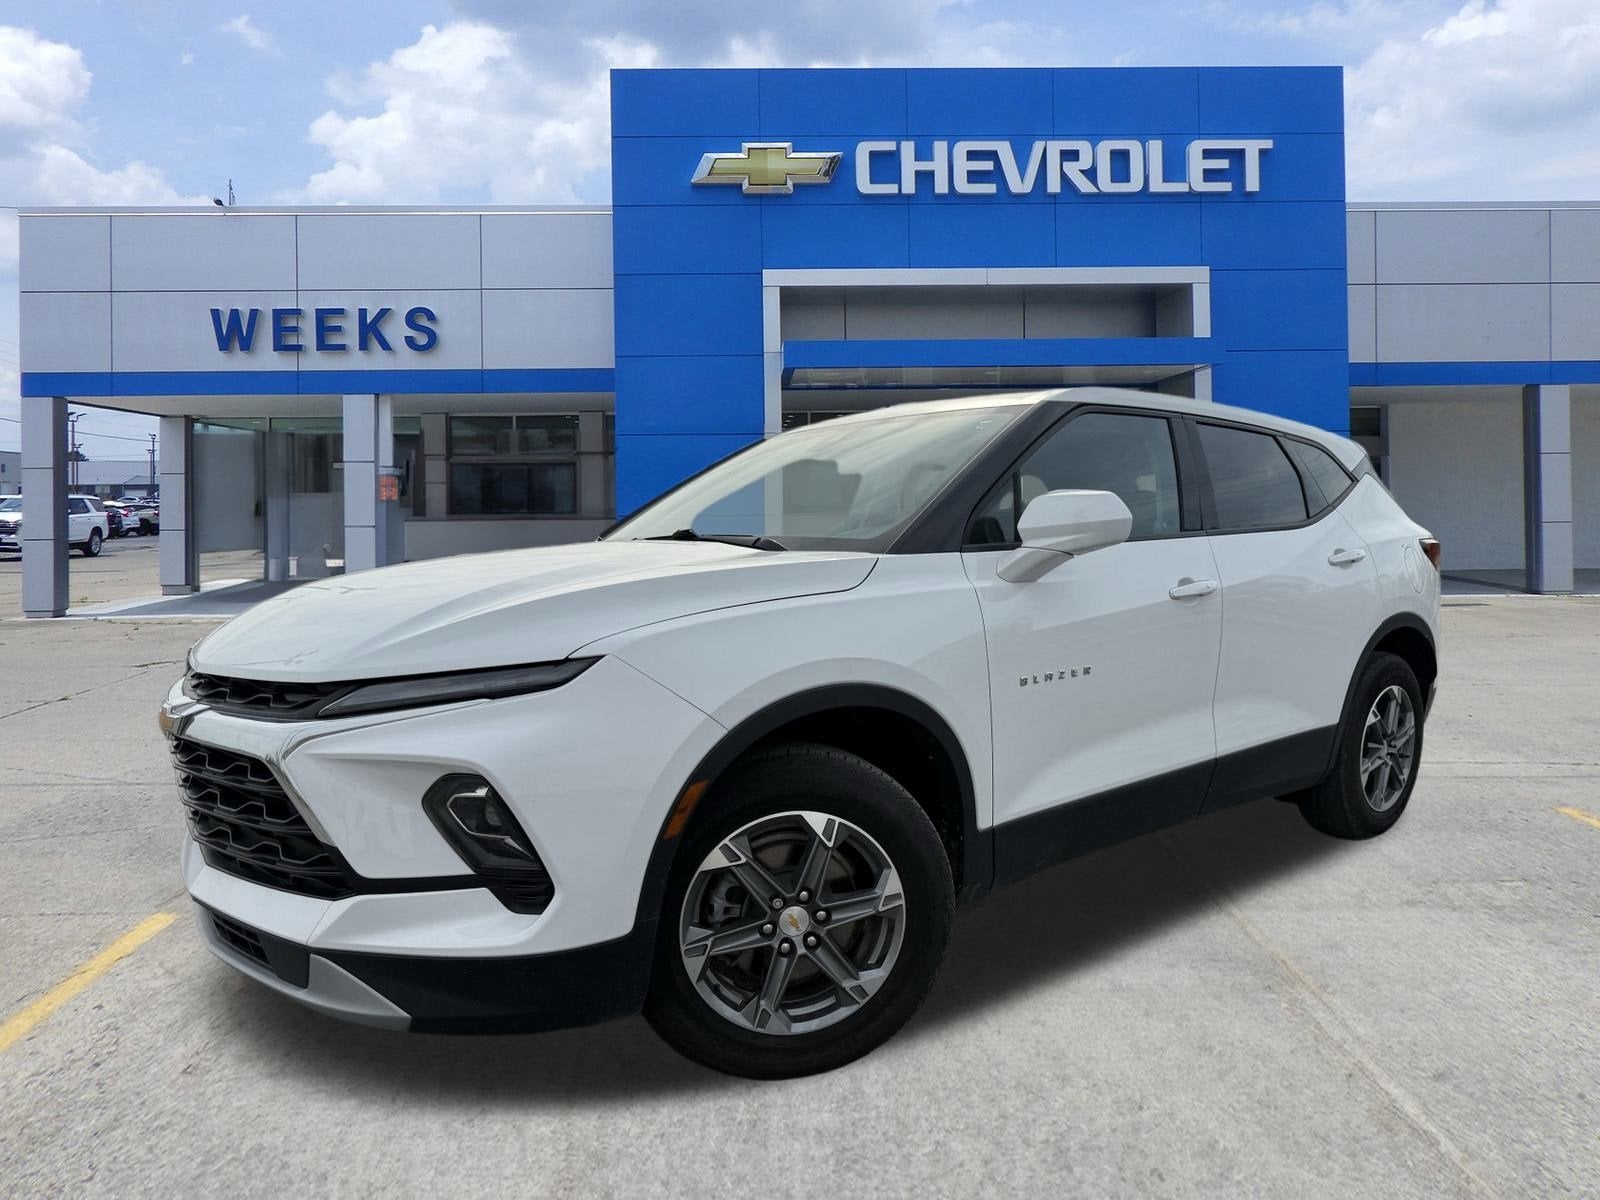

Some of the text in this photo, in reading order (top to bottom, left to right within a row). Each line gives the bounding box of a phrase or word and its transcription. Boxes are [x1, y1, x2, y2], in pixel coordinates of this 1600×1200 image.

[855, 139, 1274, 194] CHEVROLET
[210, 306, 439, 354] WEEKS
[1019, 665, 1092, 687] BLAZER
